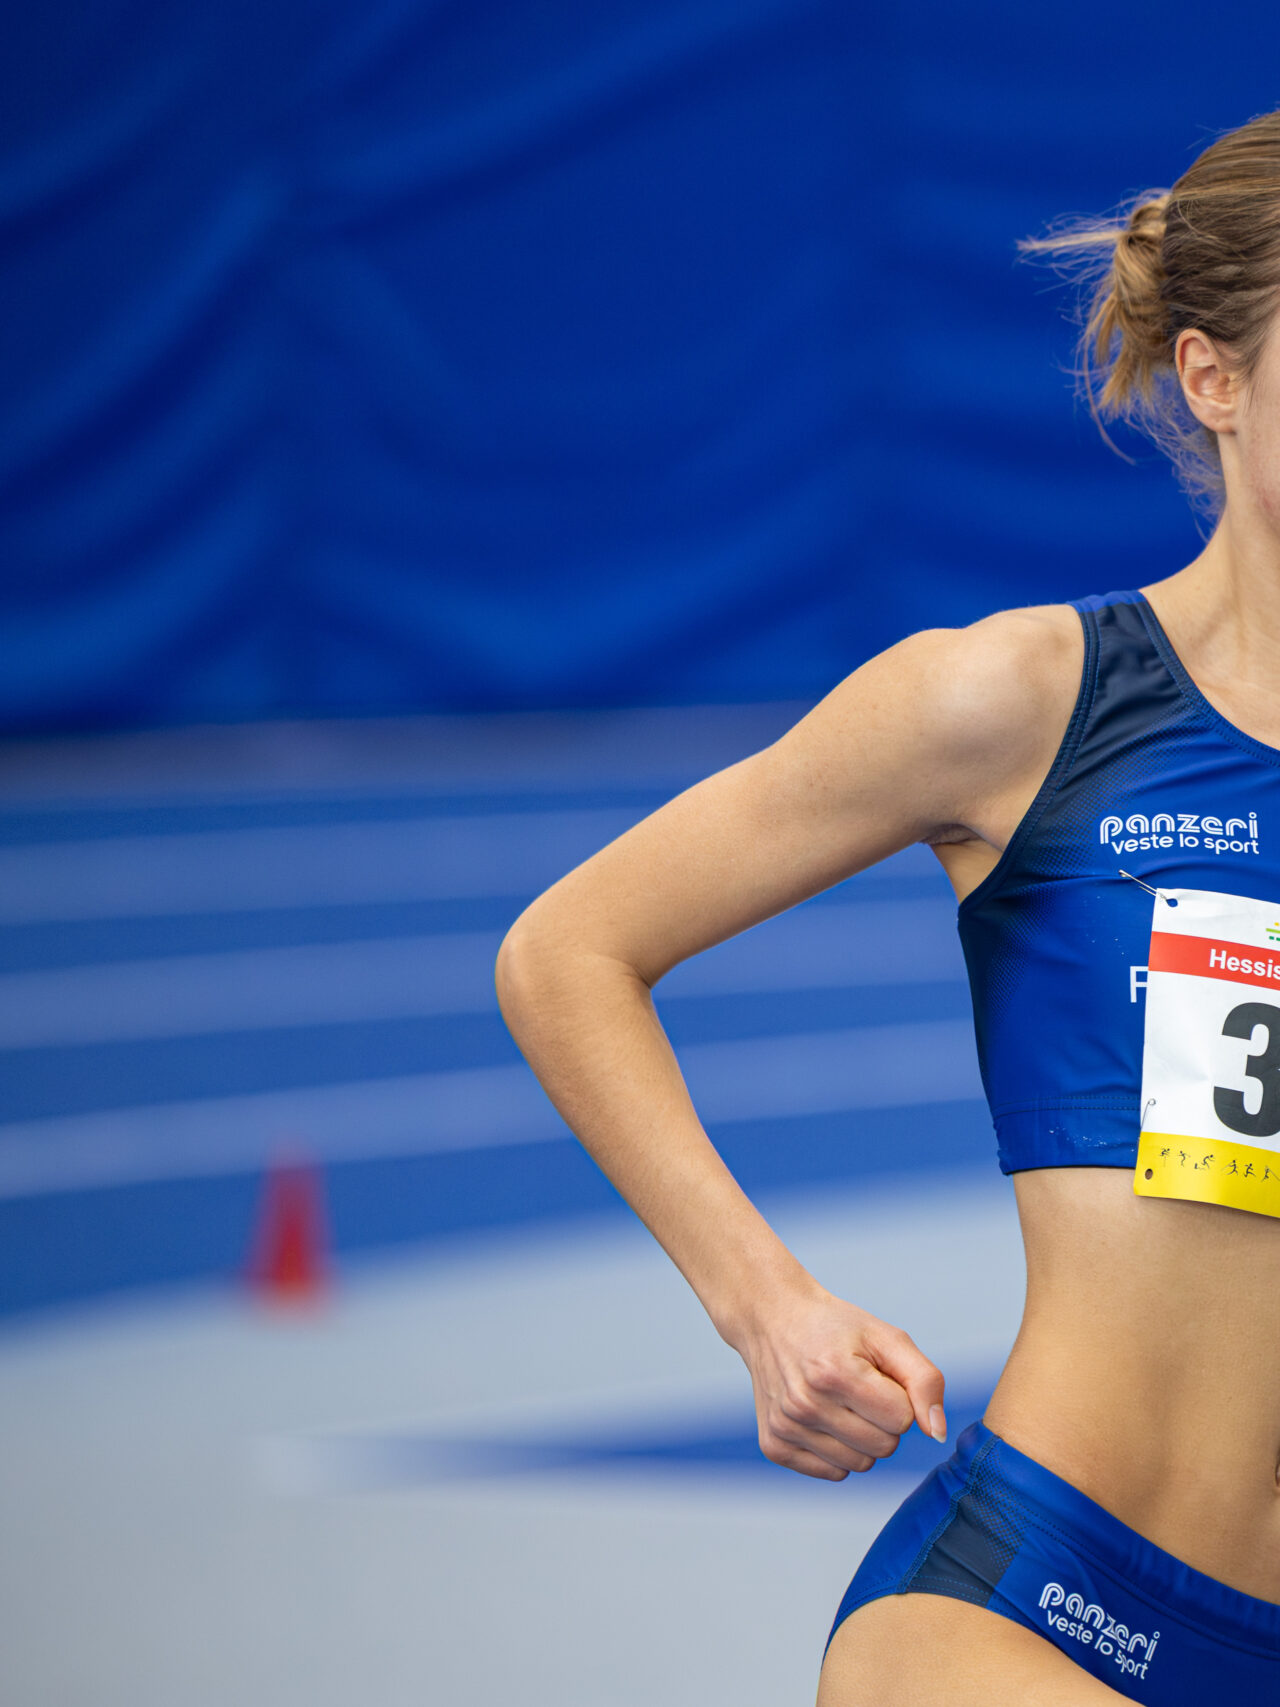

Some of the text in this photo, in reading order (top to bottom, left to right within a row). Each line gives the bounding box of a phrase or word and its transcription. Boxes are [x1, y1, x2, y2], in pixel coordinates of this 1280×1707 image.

[1100, 812, 1259, 844] panzeri
[1111, 833, 1260, 855] veste lo sport
[1038, 1582, 1161, 1662] panzeri
[1046, 1610, 1149, 1681] veste lo sport
